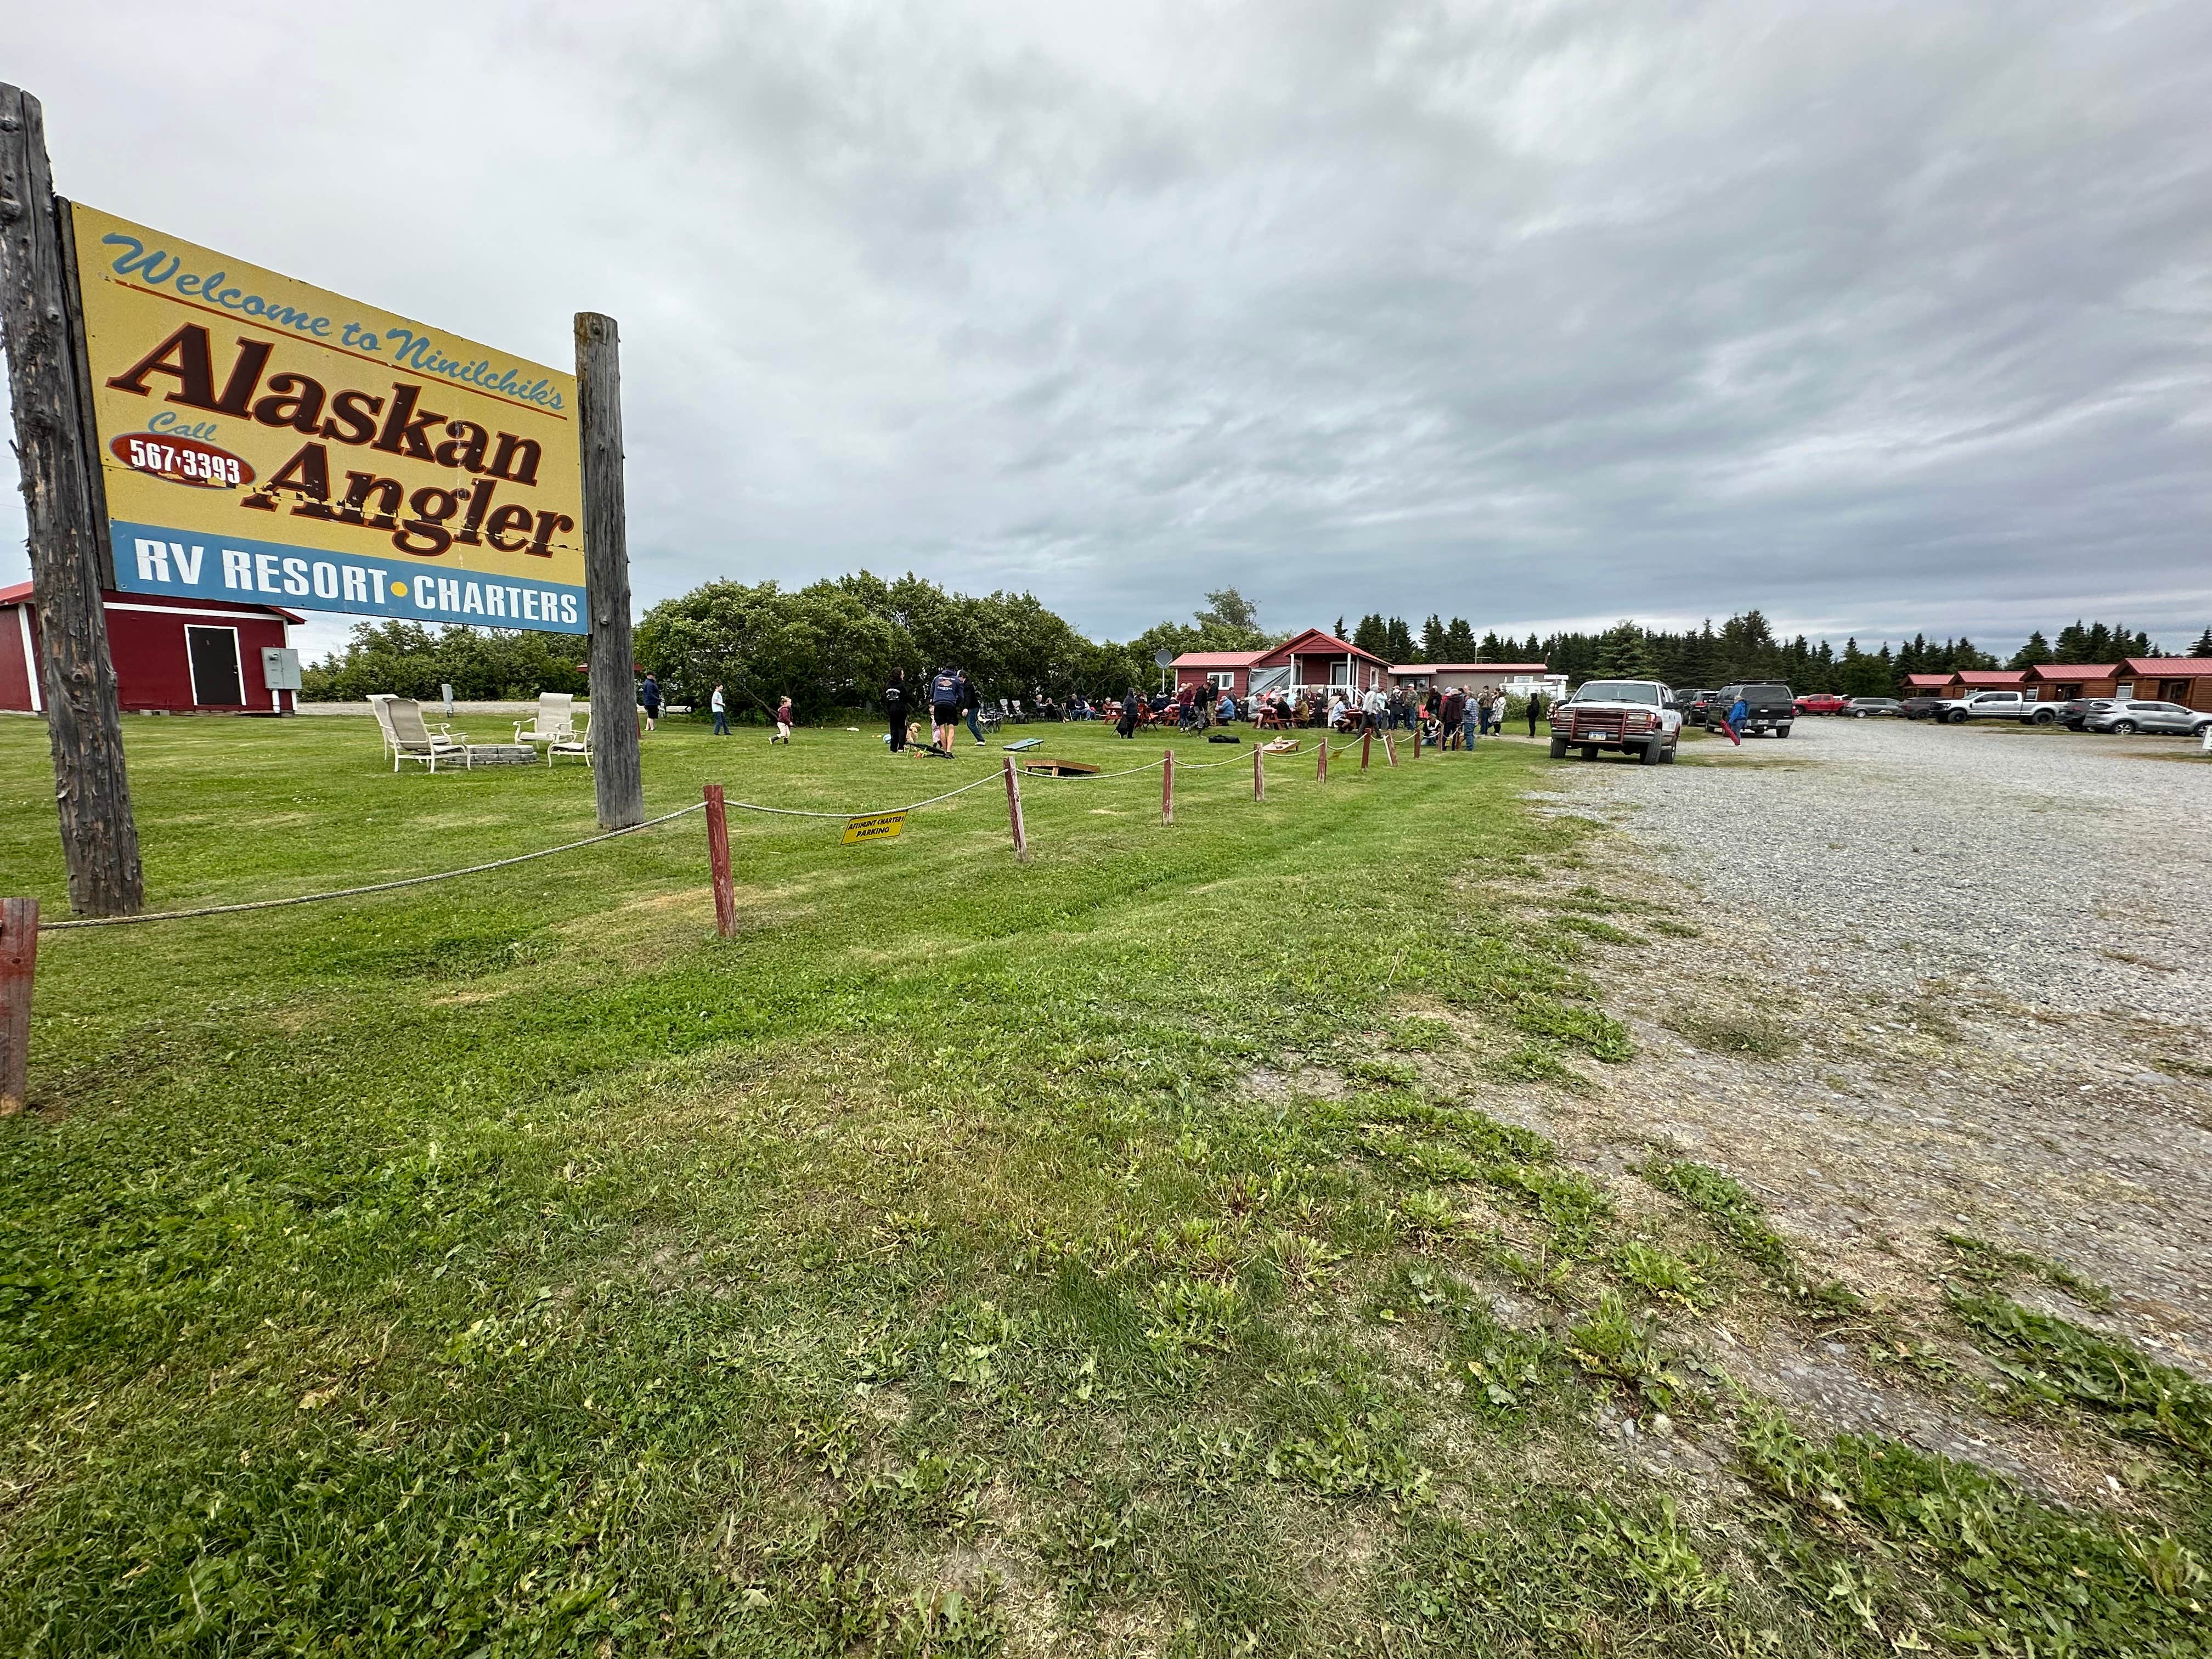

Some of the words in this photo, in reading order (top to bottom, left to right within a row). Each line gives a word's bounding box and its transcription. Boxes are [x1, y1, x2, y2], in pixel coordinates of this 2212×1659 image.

[101, 232, 332, 336] Welcome
[341, 322, 382, 351] to
[387, 328, 565, 410] Ninilchik's
[105, 322, 541, 487] Alaskan
[148, 411, 217, 442] Call
[240, 441, 574, 557] Angler
[134, 538, 204, 585] RV
[222, 549, 387, 604] RESORT
[414, 575, 578, 624] CHARTERS
[856, 826, 889, 837] PARKING
